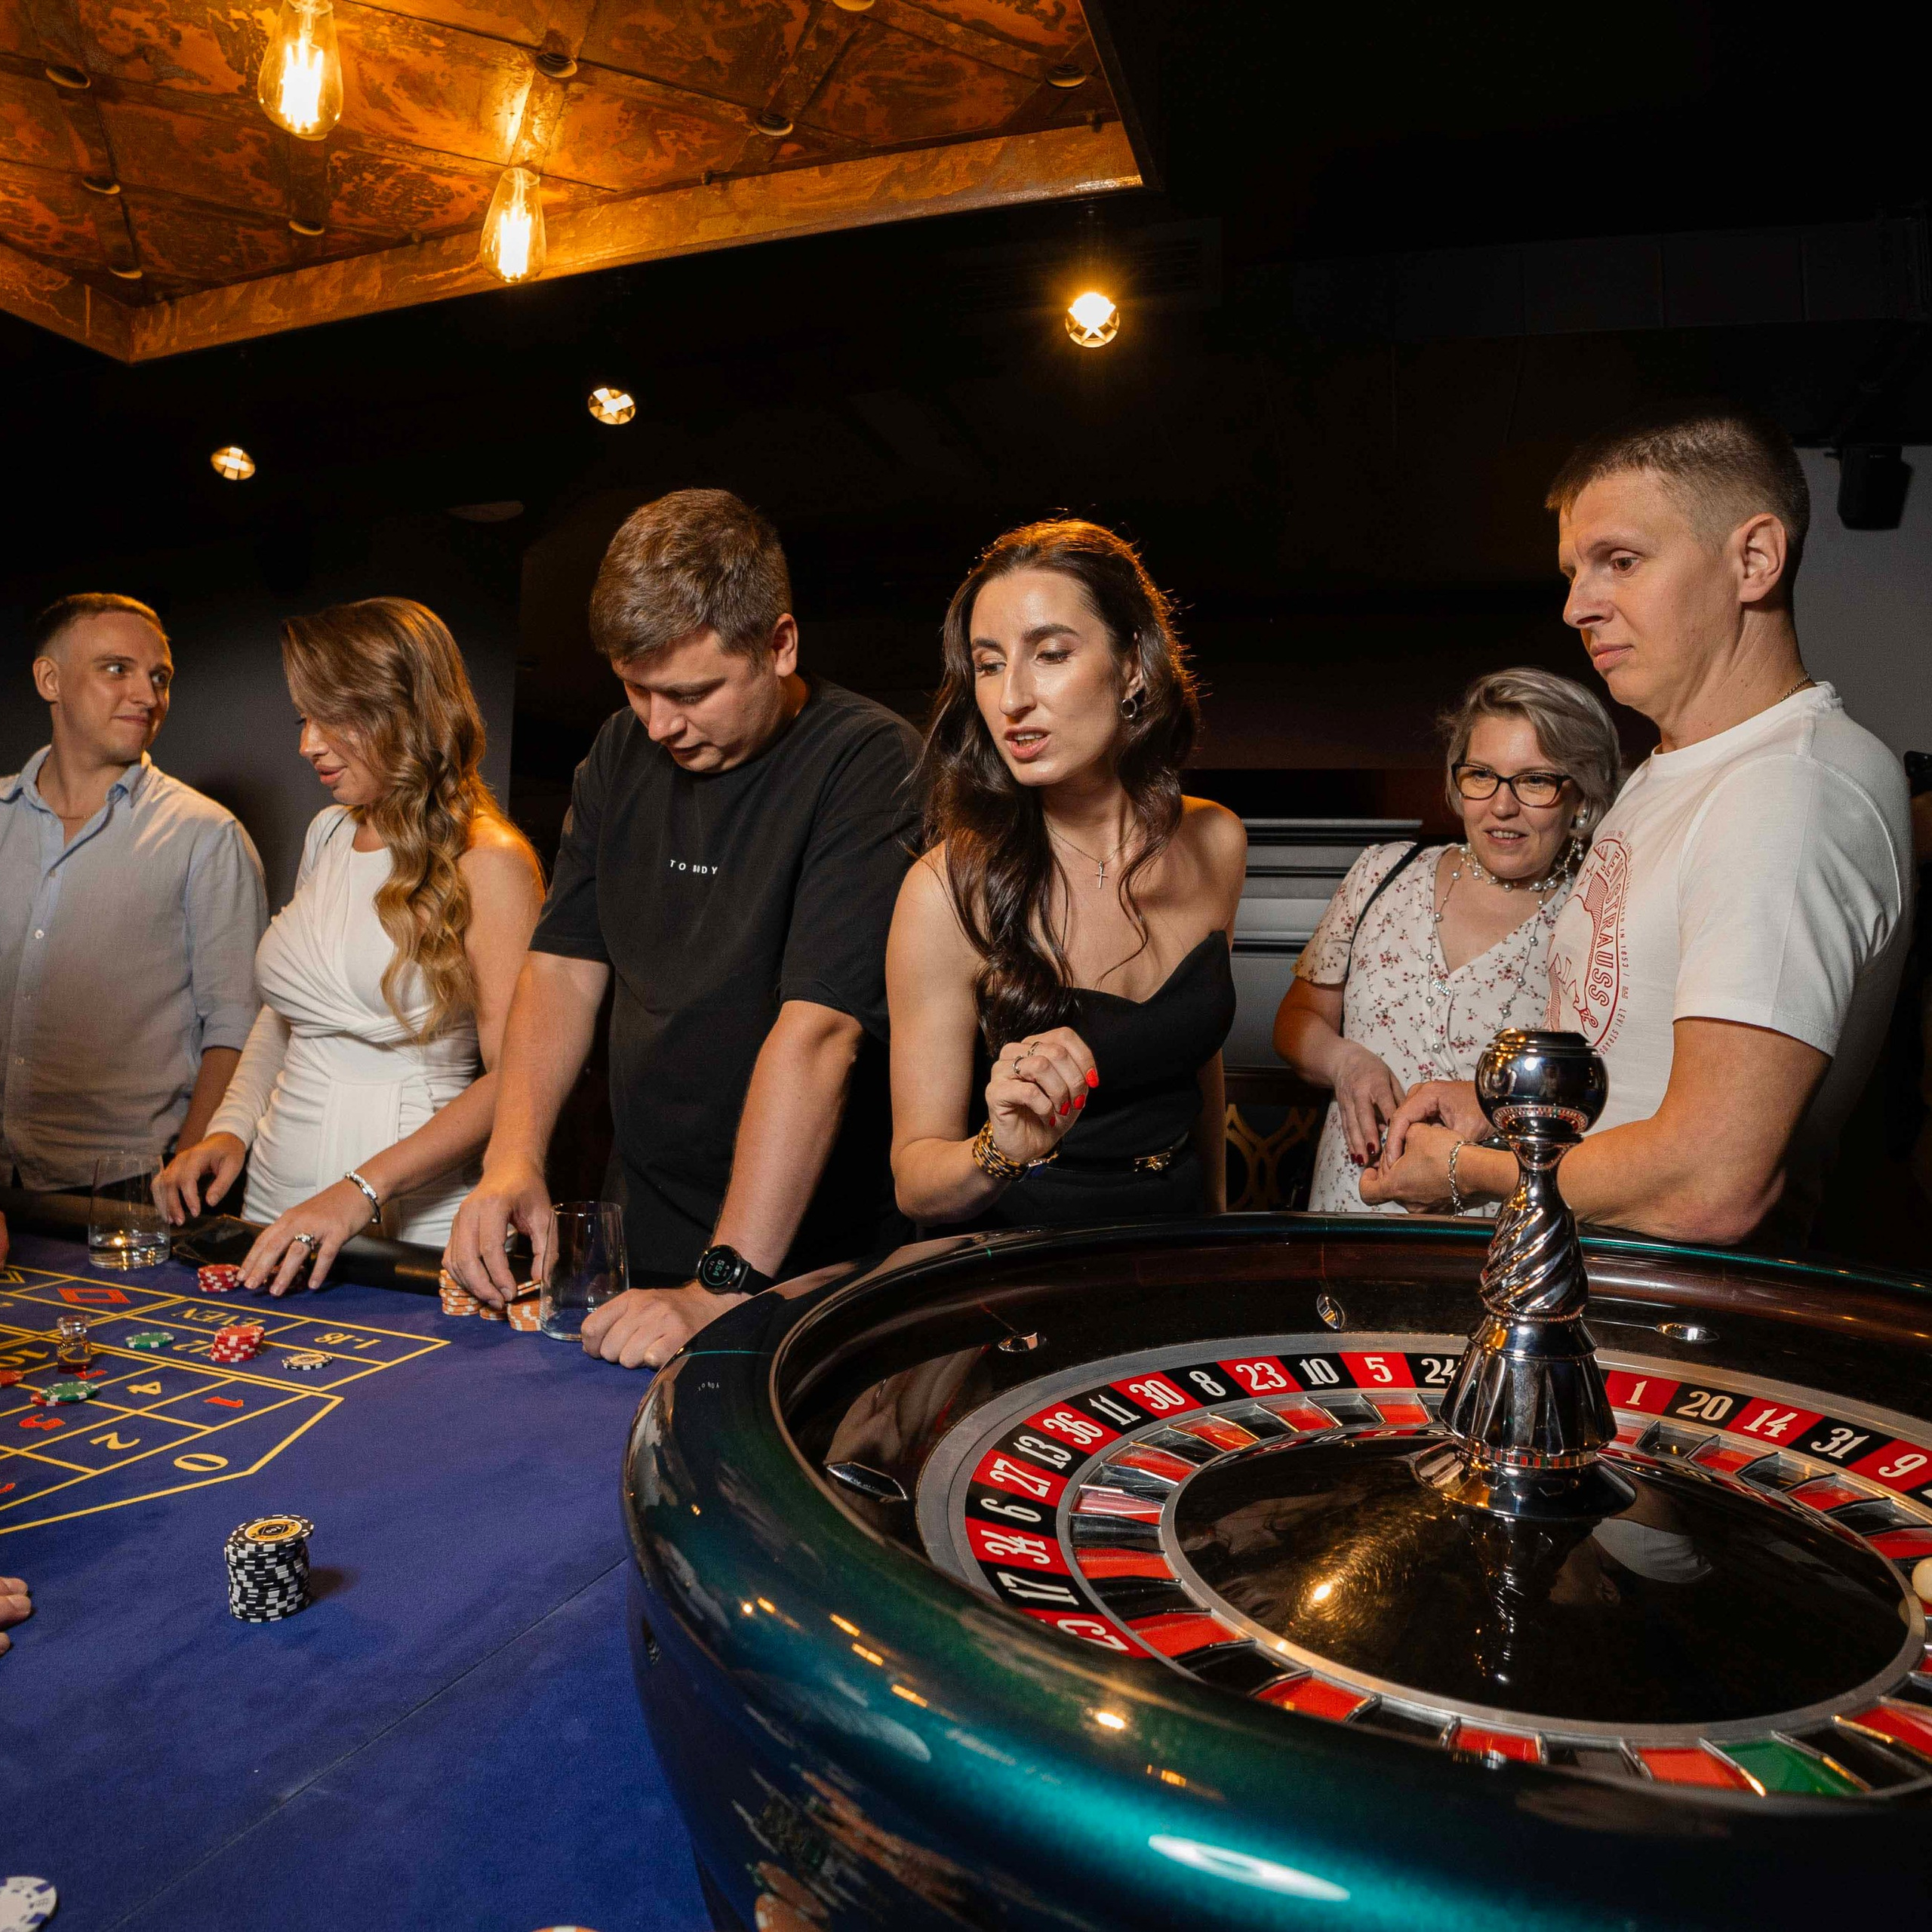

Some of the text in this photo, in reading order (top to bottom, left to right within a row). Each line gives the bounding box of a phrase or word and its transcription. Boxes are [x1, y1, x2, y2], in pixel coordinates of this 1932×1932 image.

[1588, 883, 1620, 1007] STRAUSS
[1620, 946, 1629, 968] 1853
[1615, 1008, 1626, 1028] LEVI
[314, 1333, 382, 1349] 1-18
[1189, 1371, 1226, 1396] 8
[1235, 1362, 1287, 1391] 23
[1300, 1358, 1340, 1385] 10
[1364, 1357, 1393, 1383] 5
[126, 1380, 162, 1395] 4
[1128, 1380, 1185, 1410] 30
[1626, 1380, 1647, 1406] 1
[203, 1396, 244, 1408] 1
[1089, 1395, 1141, 1426] 11
[1676, 1390, 1734, 1421] 20
[1043, 1412, 1103, 1444] 36
[1743, 1407, 1798, 1438] 14
[90, 1432, 140, 1450] 2
[1014, 1435, 1072, 1469] 13
[1811, 1427, 1870, 1460] 31
[174, 1454, 229, 1472] 0
[1878, 1454, 1928, 1478] 9
[989, 1458, 1051, 1497] 27
[980, 1499, 1041, 1522] 6
[981, 1530, 1051, 1564] 34
[997, 1572, 1080, 1605] 17
[1039, 1620, 1130, 1651] 2
